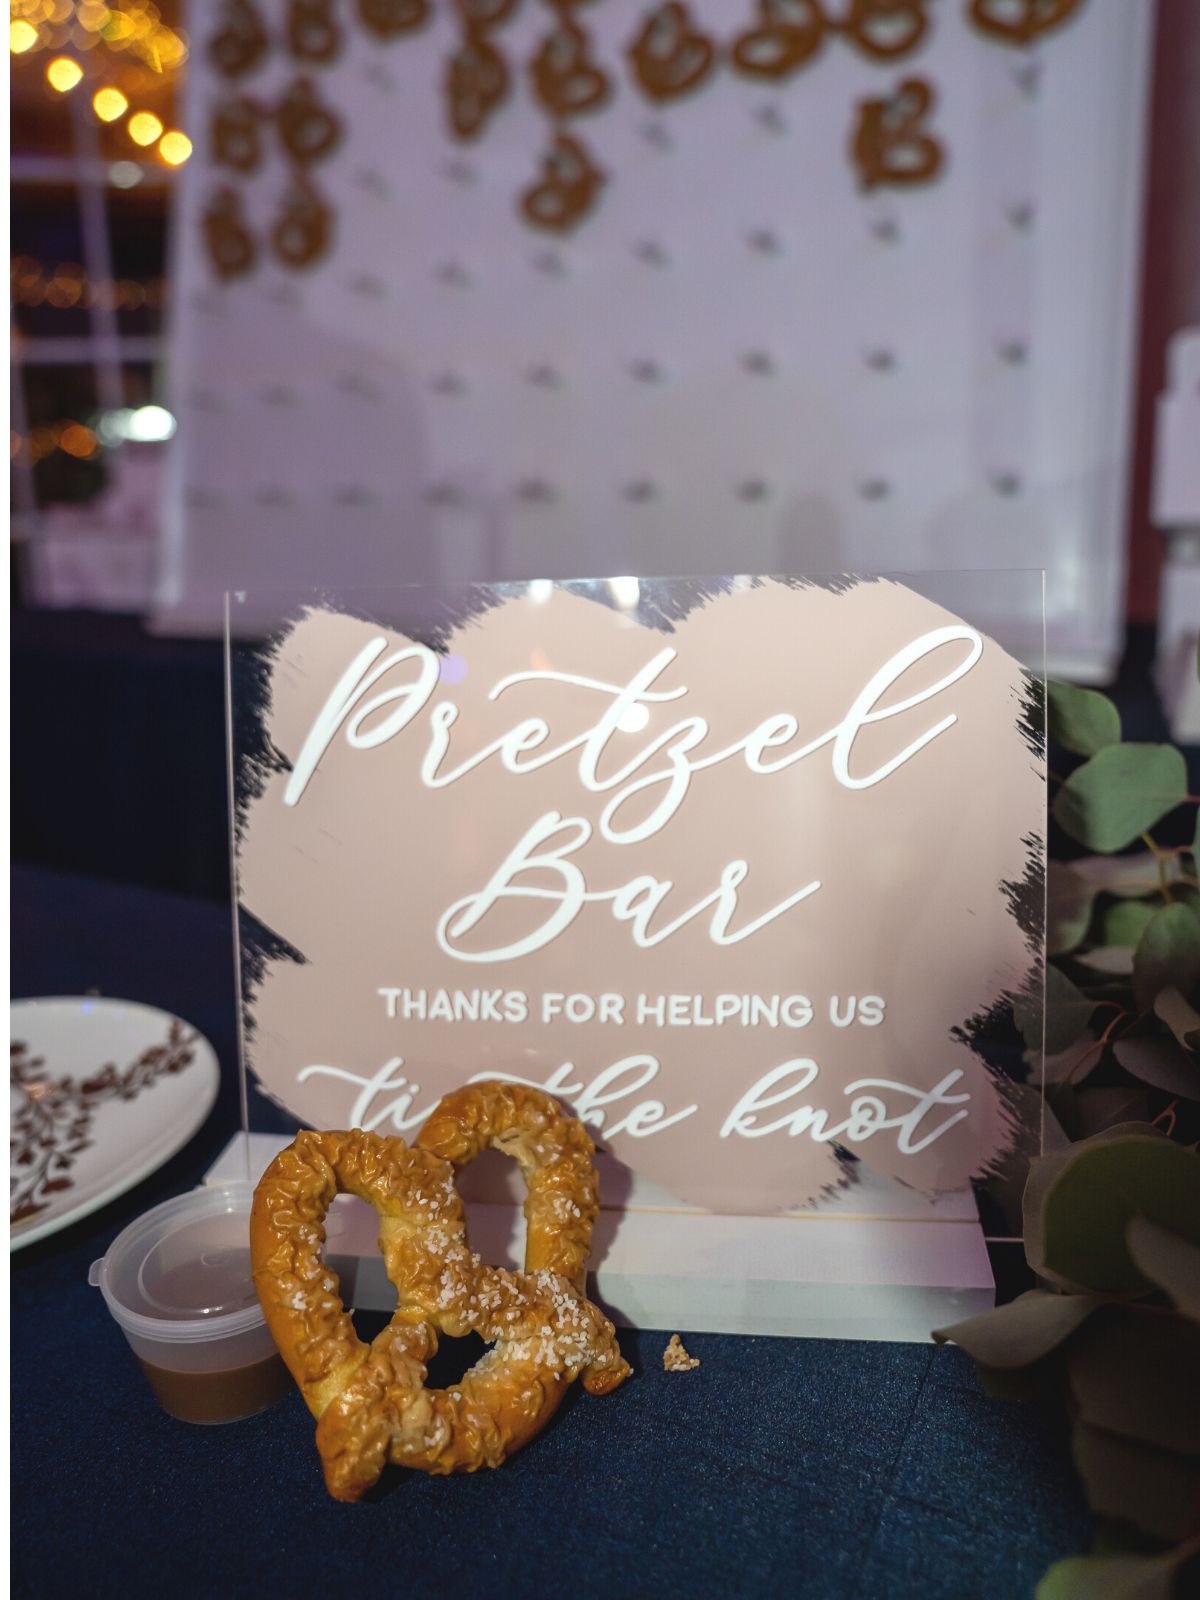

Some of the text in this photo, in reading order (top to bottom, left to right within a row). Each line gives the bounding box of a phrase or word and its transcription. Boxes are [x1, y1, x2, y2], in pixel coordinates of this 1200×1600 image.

[284, 625, 983, 844] Pretzel
[437, 811, 821, 964] Bar
[377, 986, 885, 1028] THANKS FOR HELPING US
[297, 1057, 441, 1131] ti
[720, 1056, 968, 1154] knot
